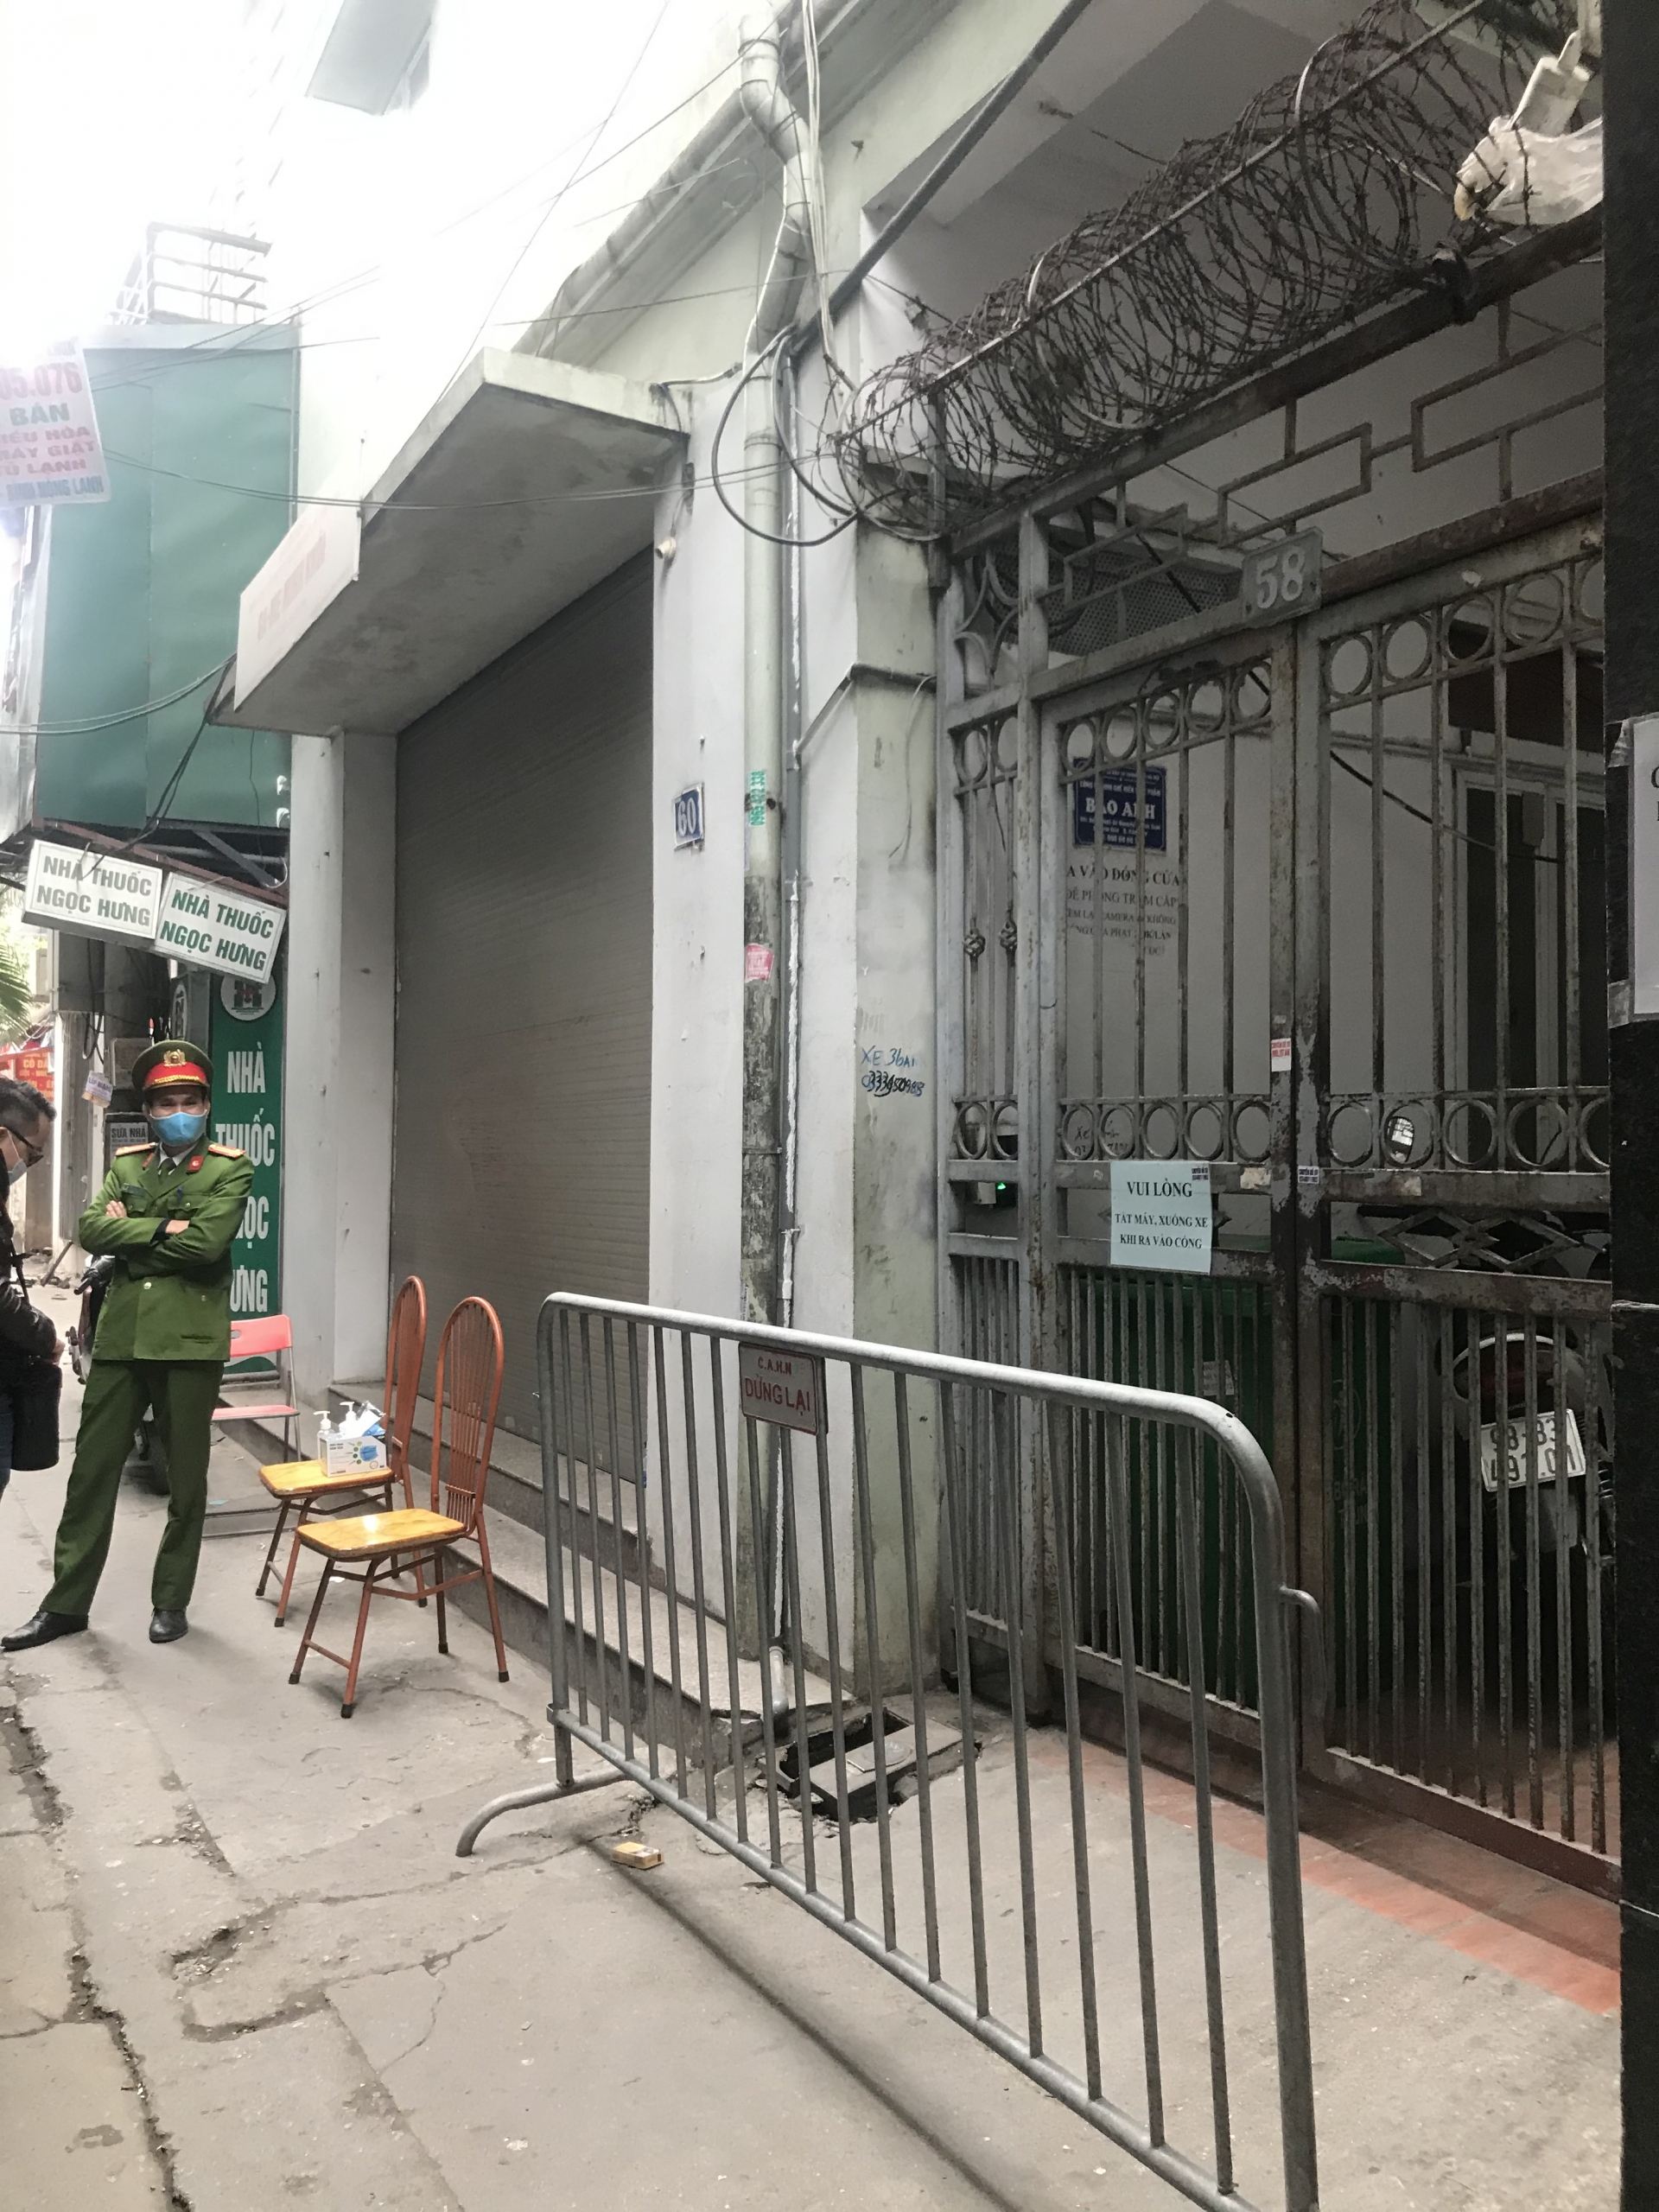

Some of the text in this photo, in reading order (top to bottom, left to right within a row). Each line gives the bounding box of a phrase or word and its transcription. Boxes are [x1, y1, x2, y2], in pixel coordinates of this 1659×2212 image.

[1256, 545, 1306, 609] 58
[678, 798, 696, 836] 60
[91, 865, 152, 897] THUỐC
[36, 885, 150, 927] NGỌC HƯNG
[171, 889, 274, 939] NHÀ THUỐC
[160, 920, 267, 971] NGỌC HƯNG
[227, 1040, 265, 1094] NHÀ
[861, 1046, 883, 1066] XE
[1127, 1178, 1192, 1198] VUI LÒNG
[1120, 1234, 1136, 1244] KHI
[1138, 1235, 1151, 1245] RA
[1153, 1234, 1173, 1247] VÀO
[1194, 1217, 1208, 1228] XE
[230, 1265, 268, 1313] ƯNG
[758, 1356, 792, 1376] C.A.H.N
[744, 1373, 810, 1416] DỪNG LẠI
